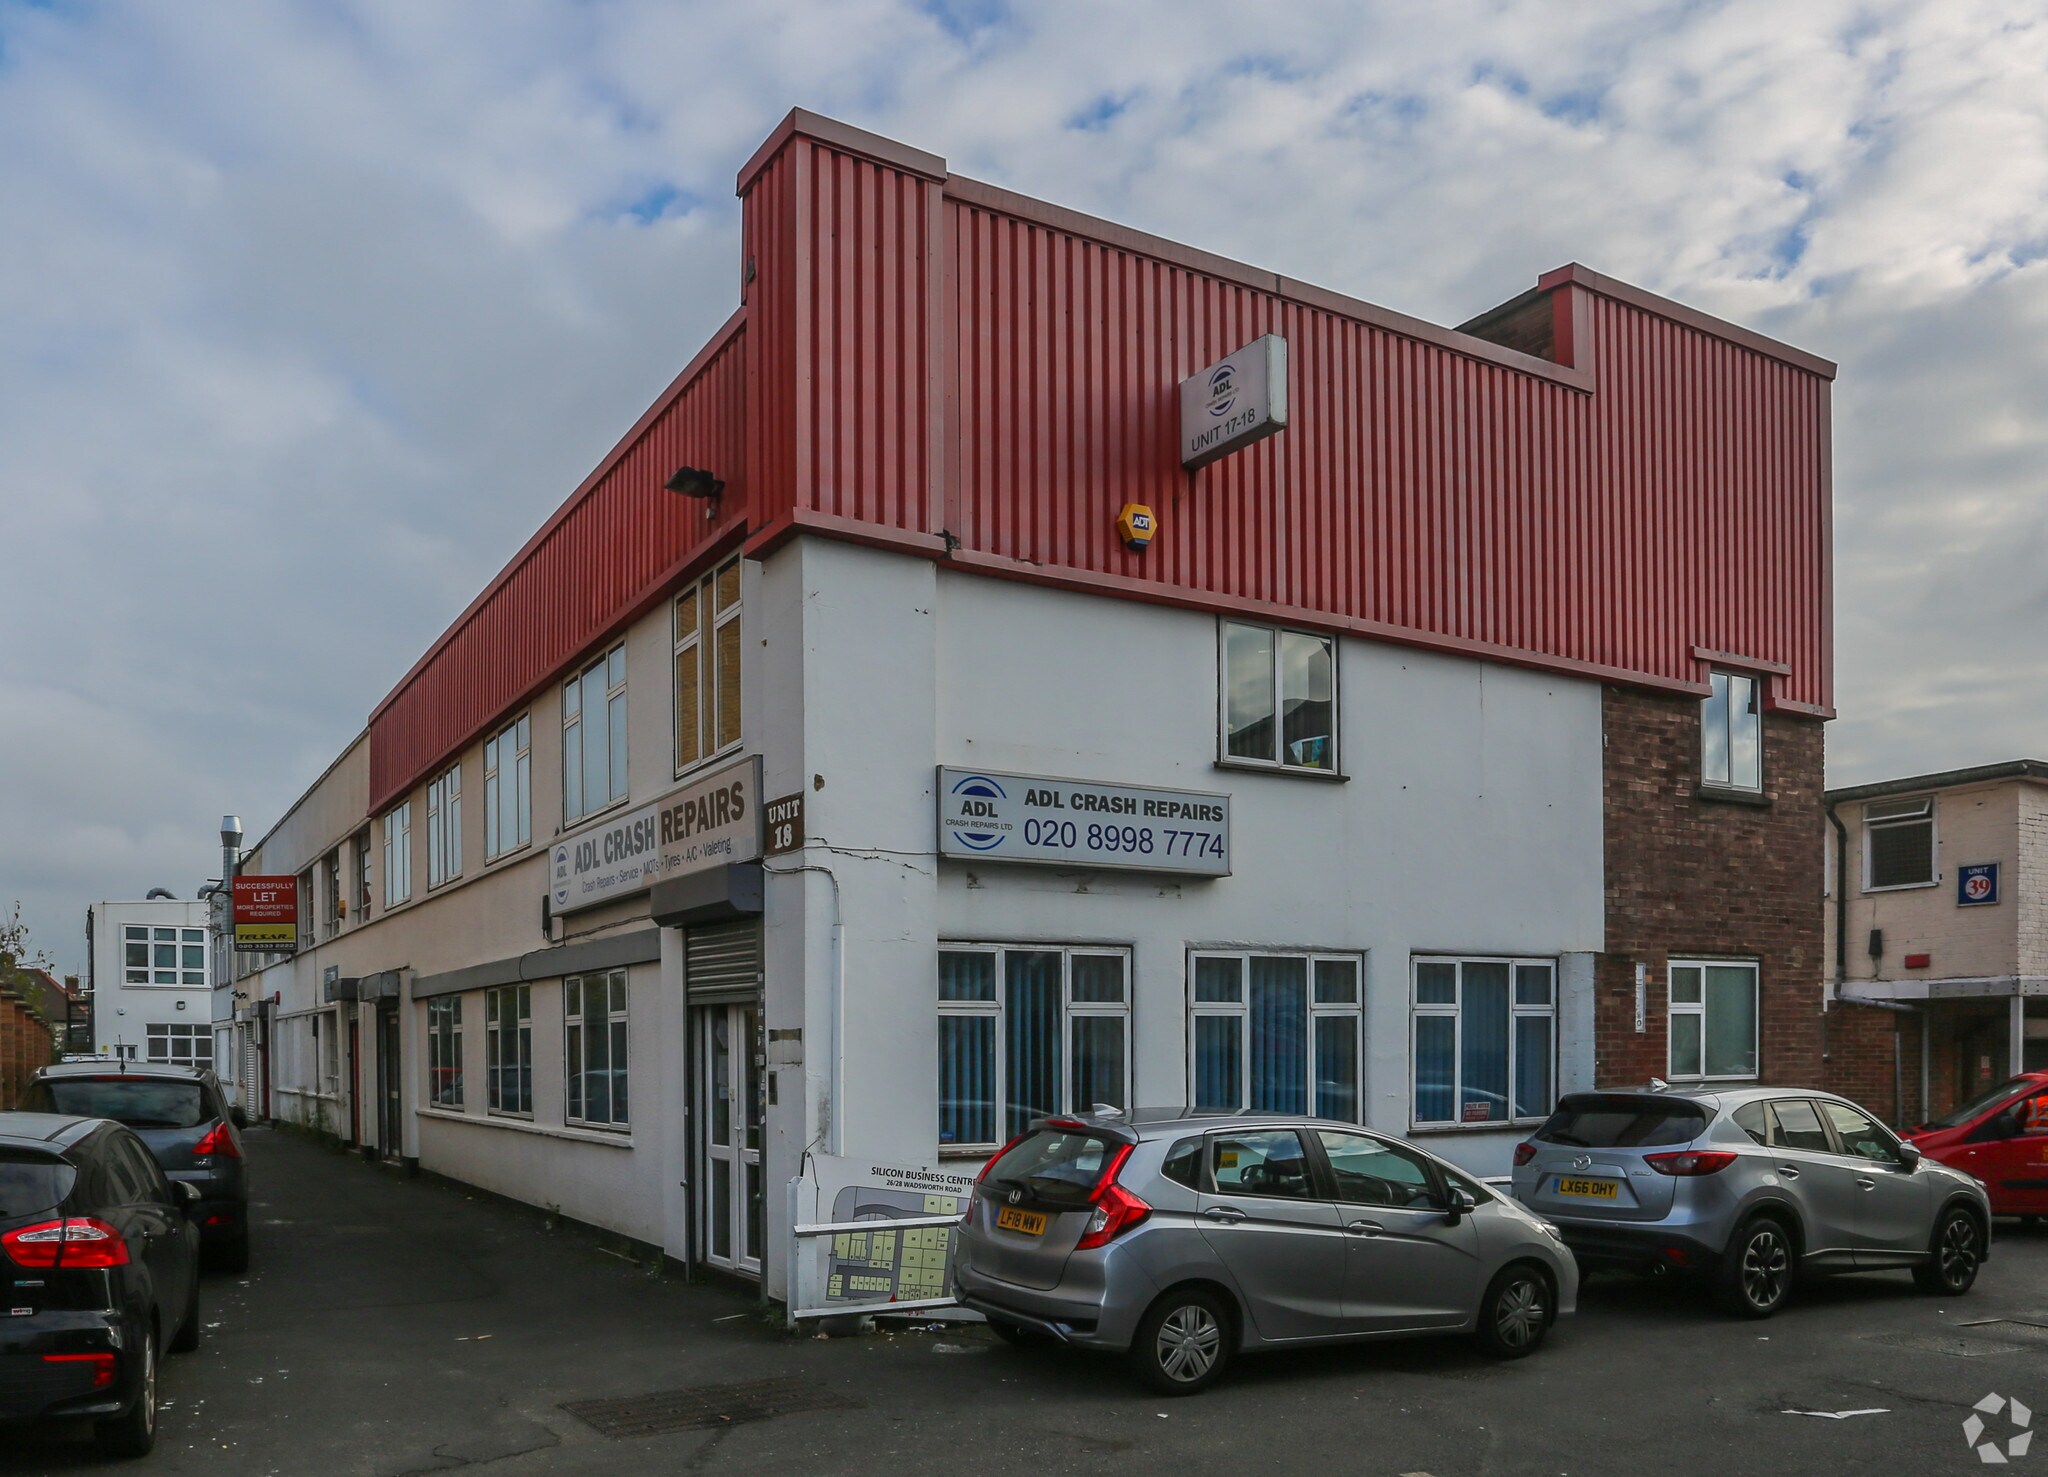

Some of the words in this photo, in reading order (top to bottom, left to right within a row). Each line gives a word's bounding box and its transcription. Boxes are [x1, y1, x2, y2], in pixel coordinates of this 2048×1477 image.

[1213, 379, 1232, 398] ADL
[1191, 425, 1221, 452] UNIT
[1225, 408, 1256, 435] 17-18
[1133, 516, 1150, 528] ADT
[768, 799, 800, 824] UNIT
[961, 800, 998, 818] ADL
[1024, 788, 1065, 809] ADL
[1070, 792, 1137, 815] CRASH
[1143, 800, 1224, 822] REPAIRS
[574, 838, 601, 876] ADL
[604, 815, 656, 865] CRASH
[661, 781, 745, 846] REPAIRS
[945, 819, 969, 828] CRASH
[970, 820, 999, 830] REPAIRS
[1000, 822, 1013, 831] LTD
[774, 825, 793, 849] 18
[1024, 818, 1077, 848] 020
[1087, 823, 1154, 854] 8998
[1163, 829, 1225, 859] 7774
[597, 873, 616, 889] Repairs
[620, 867, 639, 883] Service
[643, 858, 660, 875] MOTs
[664, 854, 681, 872] Tyres
[686, 845, 698, 864] A/C
[703, 836, 732, 858] Valeting
[1968, 866, 1989, 875] UNIT
[557, 865, 568, 879] ADL
[235, 882, 294, 890] SUCCESSFULLY
[1968, 879, 1990, 897] 39
[253, 892, 277, 902] LET
[871, 1166, 904, 1179] SILICON
[905, 1170, 945, 1183] BUSINESS
[886, 1179, 903, 1187] 26/28
[903, 1181, 944, 1192] WADSWORTH
[1560, 1179, 1589, 1193] LX66
[1591, 1182, 1616, 1196] OHY
[1000, 1210, 1021, 1228] LF18
